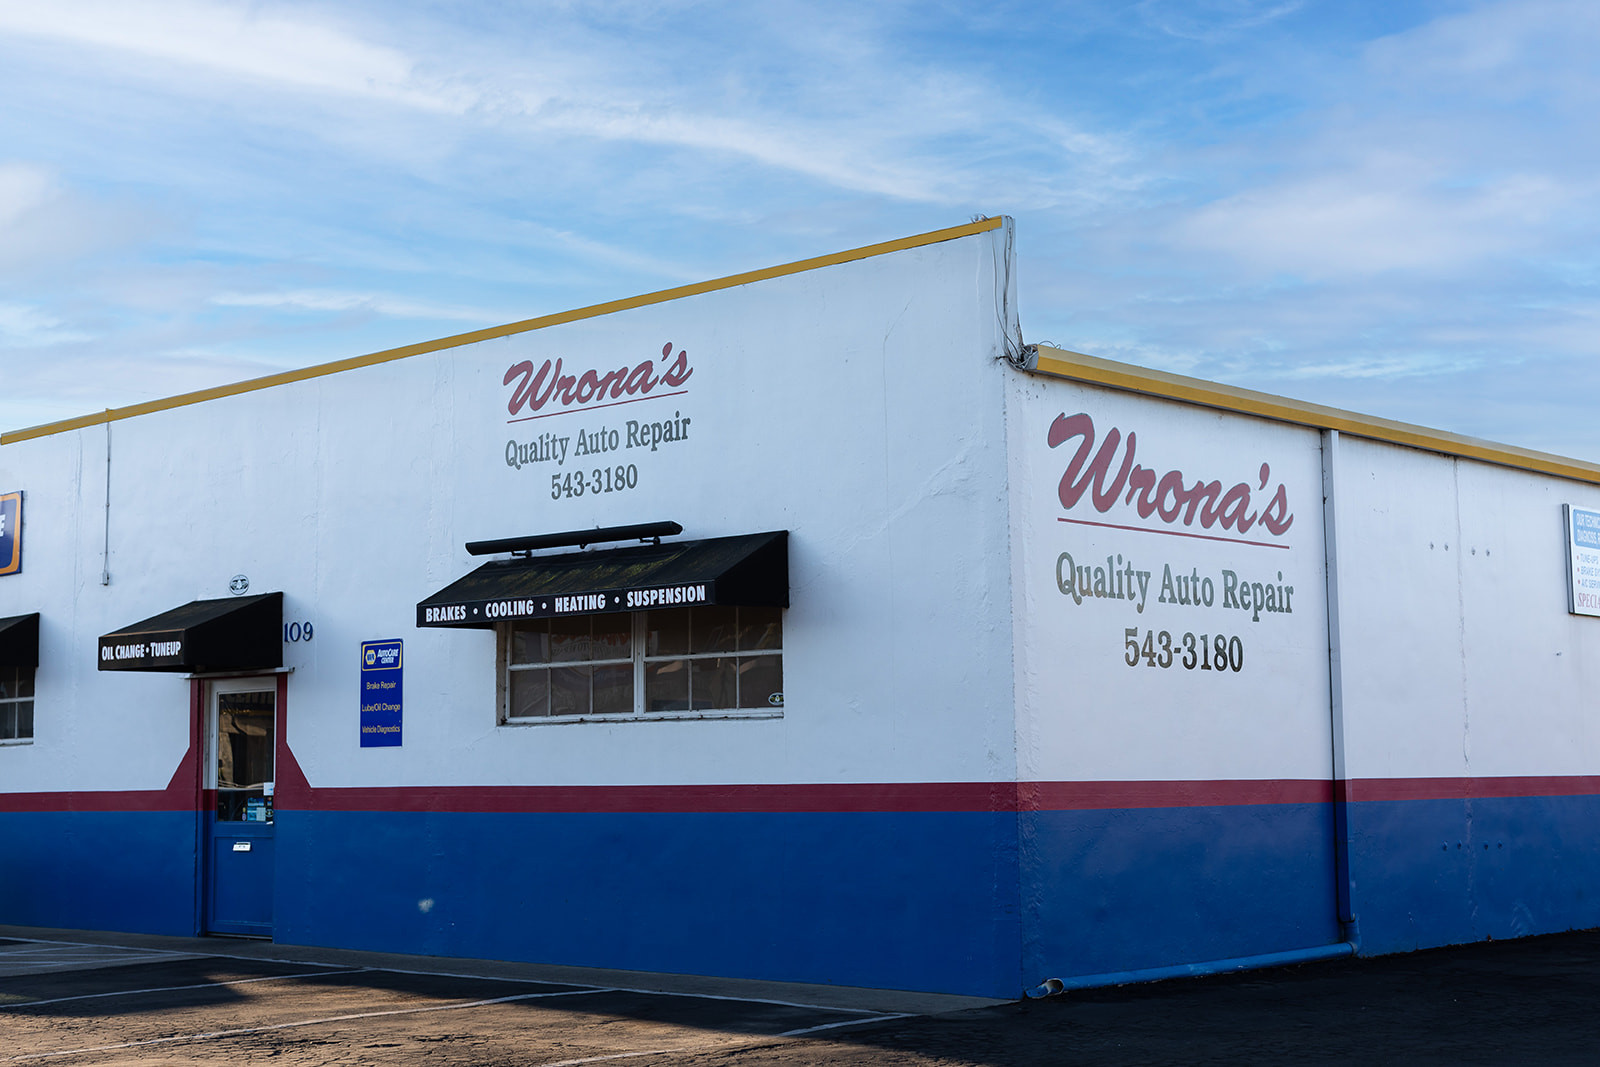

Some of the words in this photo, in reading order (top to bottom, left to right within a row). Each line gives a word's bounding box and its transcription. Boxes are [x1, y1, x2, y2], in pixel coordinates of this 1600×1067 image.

[503, 342, 694, 416] Wrona's
[505, 432, 570, 470] Quality
[574, 426, 619, 457] Auto
[625, 410, 691, 452] Repair
[551, 464, 638, 500] 543-3180
[1047, 412, 1294, 536] Wrona's
[425, 605, 467, 622] BRAKES
[485, 600, 534, 618] COOLING
[554, 594, 606, 613] HEATING
[626, 585, 706, 608] SUSPENSION
[1056, 551, 1151, 614] Quality
[1158, 563, 1214, 607] Auto
[1222, 569, 1294, 622] Repair
[284, 621, 313, 643] 109
[1124, 627, 1243, 673] 543-3180
[101, 646, 114, 661] OIL
[115, 643, 145, 660] CHANGE
[150, 641, 181, 657] TUNEUP
[366, 681, 380, 690] Brake
[380, 680, 397, 690] Repair
[382, 702, 401, 713] Change
